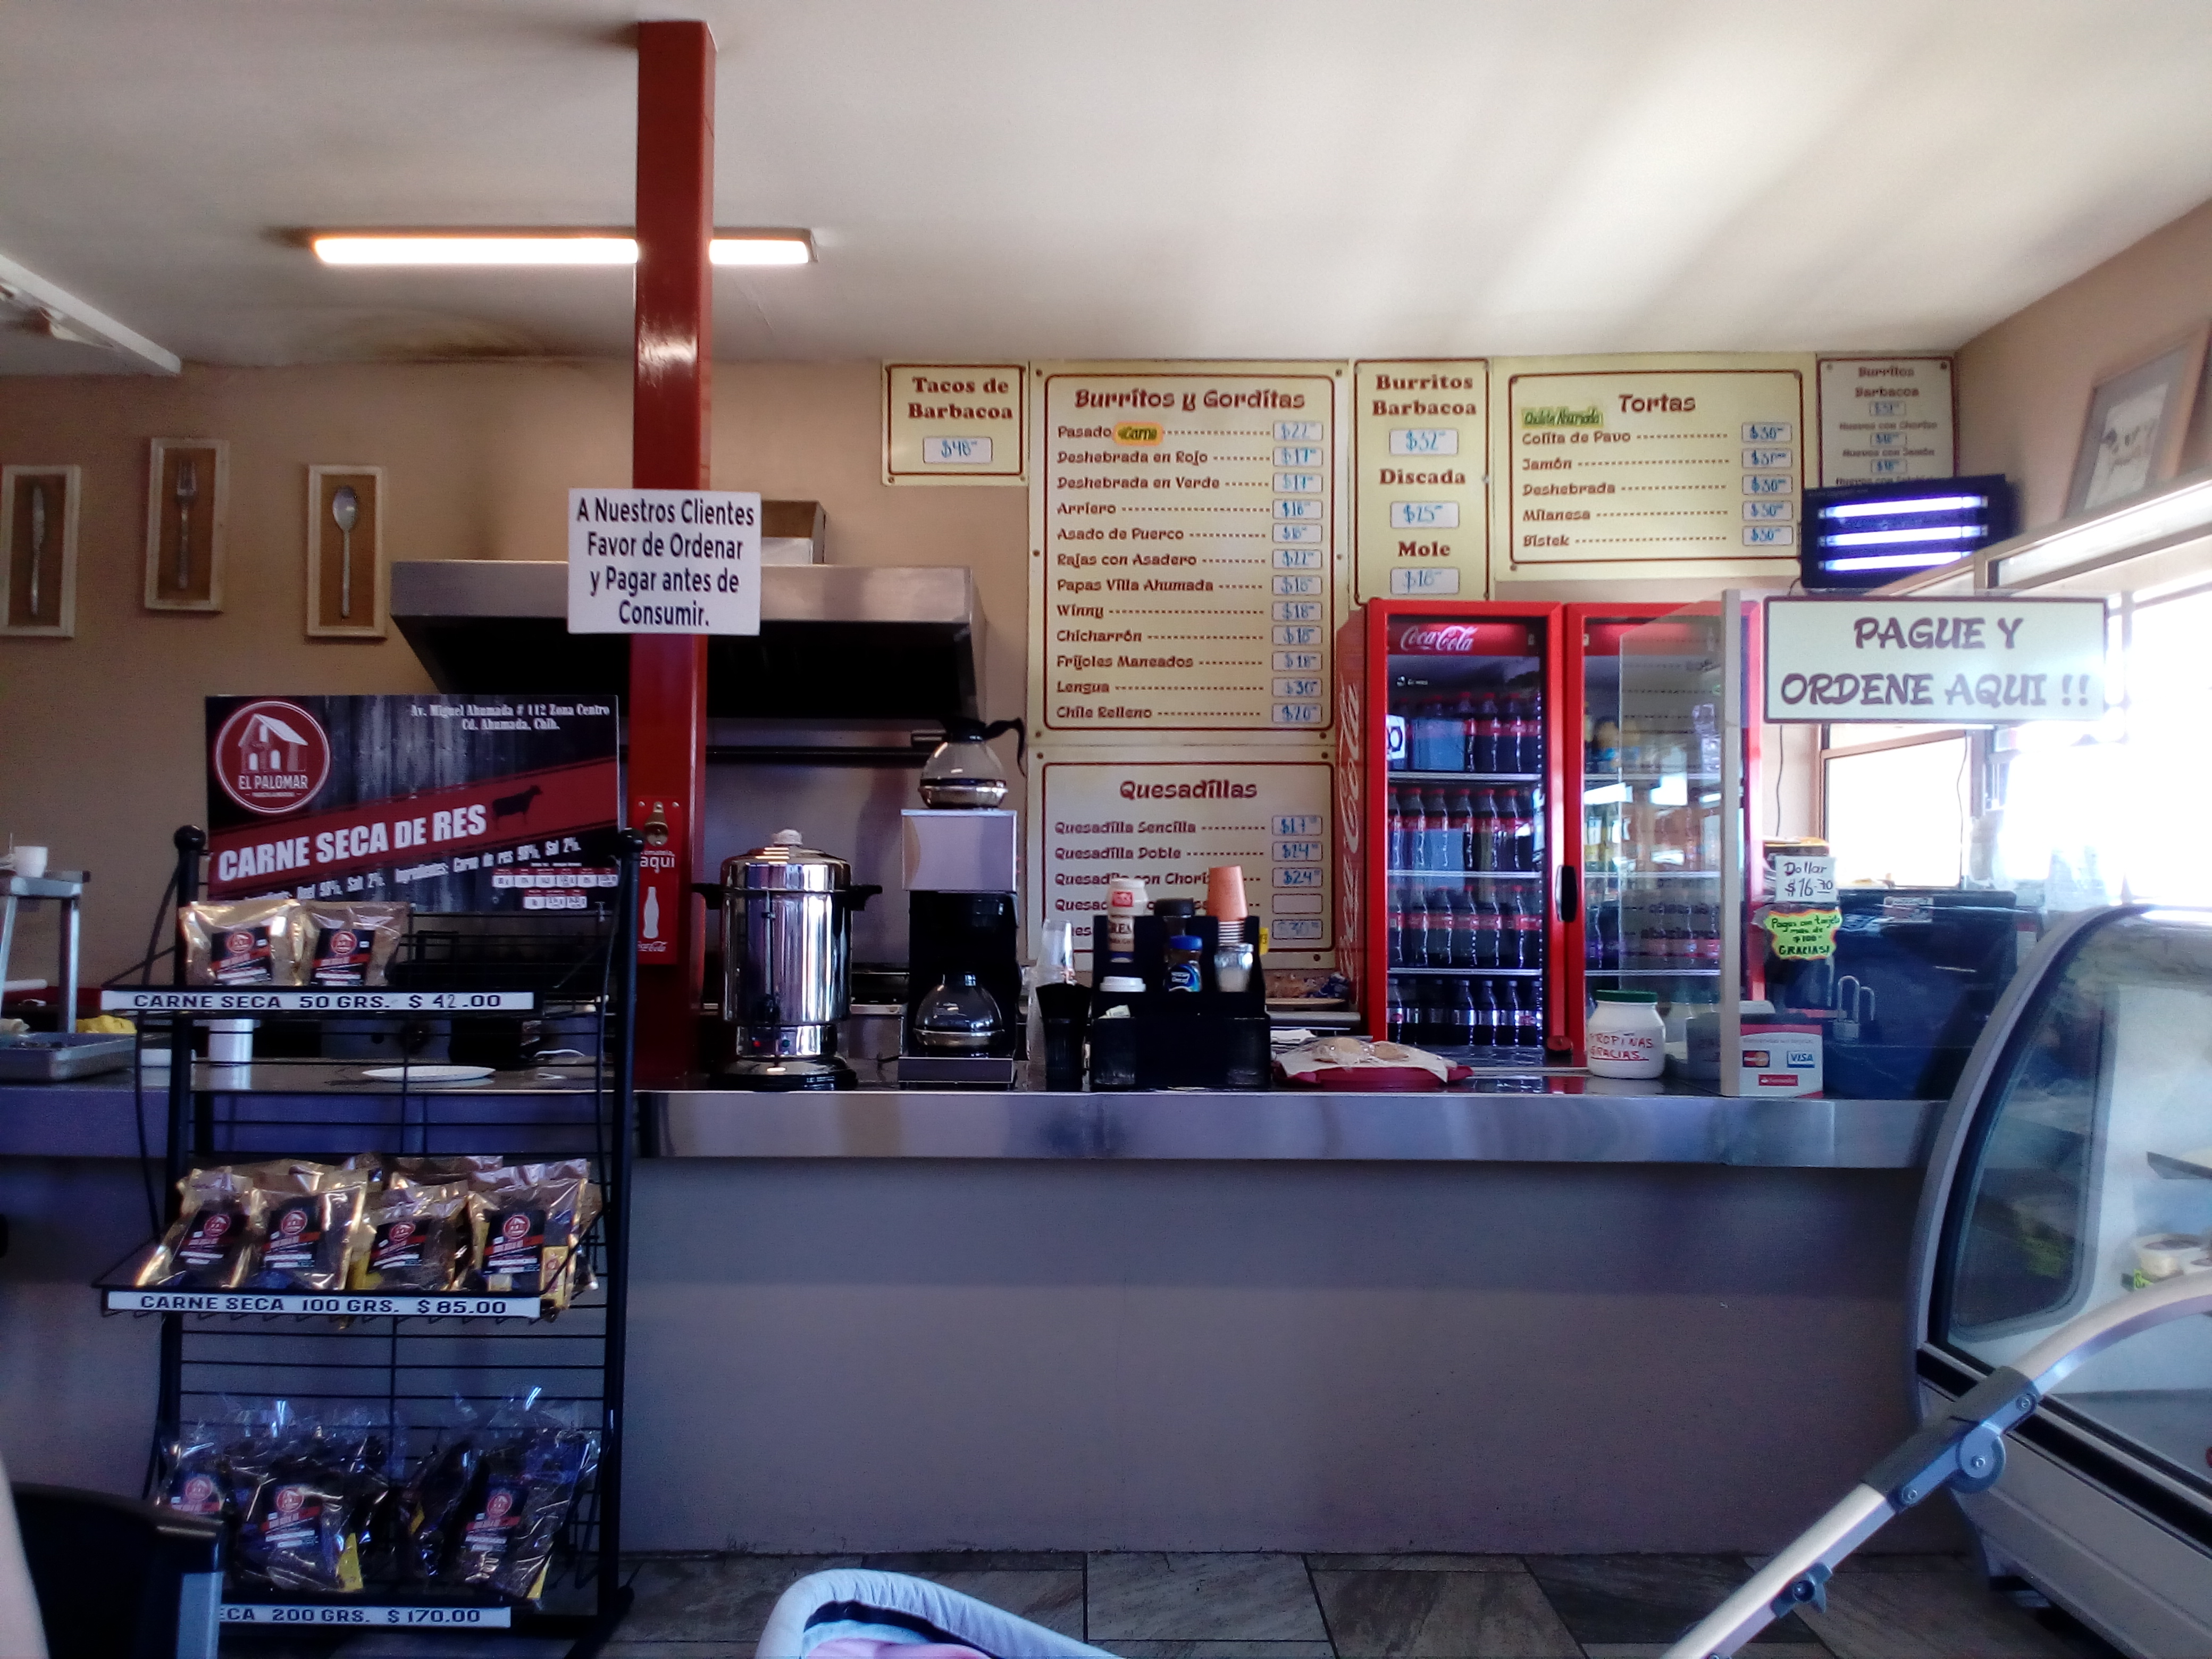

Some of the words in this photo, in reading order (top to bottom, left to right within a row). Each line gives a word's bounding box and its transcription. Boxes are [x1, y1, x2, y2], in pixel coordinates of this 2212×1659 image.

[1858, 366, 1914, 378] Burritos
[911, 376, 976, 393] Tacos
[983, 378, 1009, 393] de
[1376, 374, 1473, 390] Burritos
[1855, 387, 1919, 398] Barbacoa
[1074, 389, 1175, 408] Burritos
[1182, 391, 1196, 412] y
[1204, 389, 1305, 408] Gorditas
[1372, 400, 1477, 416] Barbacoa
[1618, 393, 1696, 414] Tortas
[908, 403, 1013, 419] Barbacoa
[1058, 427, 1112, 438] Pasado
[1522, 431, 1565, 445] Colita
[1570, 431, 1588, 443] de
[1594, 430, 1631, 443] Pavo
[1057, 451, 1149, 464] Deshebrada
[1153, 454, 1170, 463] en
[1176, 451, 1208, 466] Rojo
[1522, 458, 1572, 471] Jamón
[1057, 477, 1149, 489] Deshebrada
[1153, 480, 1170, 489] en
[1176, 477, 1220, 489] Verde
[1379, 468, 1465, 485] Discada
[1522, 482, 1615, 496] Deshebrada
[577, 497, 590, 522] A
[595, 496, 675, 523] Nuestros
[681, 497, 754, 526] Clientes
[1057, 502, 1117, 515] Arriero
[1523, 509, 1590, 522] Milanesa
[1057, 528, 1104, 541] Asado
[1109, 529, 1126, 540] de
[1132, 527, 1184, 540] Puerco
[1523, 534, 1570, 548] Bistek
[588, 531, 636, 557] Favor
[642, 531, 664, 557] de
[670, 532, 743, 560] Ordenar
[1397, 540, 1451, 557] Mole
[1057, 555, 1096, 569] Rajas
[1102, 555, 1127, 566] con
[1133, 554, 1197, 566] Asadero
[590, 570, 600, 597] y
[606, 565, 657, 597] Pagar
[663, 567, 711, 592] antes
[717, 567, 740, 593] de
[1057, 579, 1102, 593] Papas
[1107, 579, 1139, 592] Villa
[1144, 579, 1213, 592] Ahumada
[619, 599, 709, 627] Consumir.
[1057, 604, 1104, 618] Winny
[1057, 629, 1142, 642] Chicharrón
[1401, 625, 1479, 651] Coca-Cola
[1853, 617, 1987, 649] PAGUE
[1997, 617, 2023, 650] Y
[1057, 655, 1112, 670] Frijoles
[1117, 656, 1193, 668] Maneados
[1057, 681, 1110, 695] Lengua
[1781, 673, 1935, 706] ORDENE
[1945, 674, 2047, 708] AQUI
[467, 704, 514, 716] Ahumada
[576, 703, 610, 716] Centro
[1057, 706, 1093, 718] Chile
[1097, 706, 1152, 719] Relleno
[238, 775, 252, 790] EL
[254, 775, 308, 790] PALOMAR
[1120, 779, 1258, 800] Quesadillas
[1054, 820, 1134, 835] Quesadilla
[1137, 820, 1196, 834] Sencilla
[218, 836, 311, 882] CARNE
[315, 822, 389, 864] SECA
[394, 817, 427, 849] DE
[433, 804, 487, 841] RES
[1054, 847, 1134, 860] Quesadilla
[1137, 847, 1181, 860] Doble
[1783, 861, 1827, 876] Dollar
[134, 994, 213, 1009] CARNE
[221, 995, 281, 1009] SECA
[299, 995, 330, 1009] 50
[337, 995, 390, 1009] GRS.
[140, 1295, 218, 1310] CARNE
[225, 1297, 284, 1311] SECA
[301, 1298, 340, 1312] 100
[347, 1300, 399, 1313] GRS.
[272, 1609, 314, 1621] 200
[321, 1609, 370, 1622] GRS.
